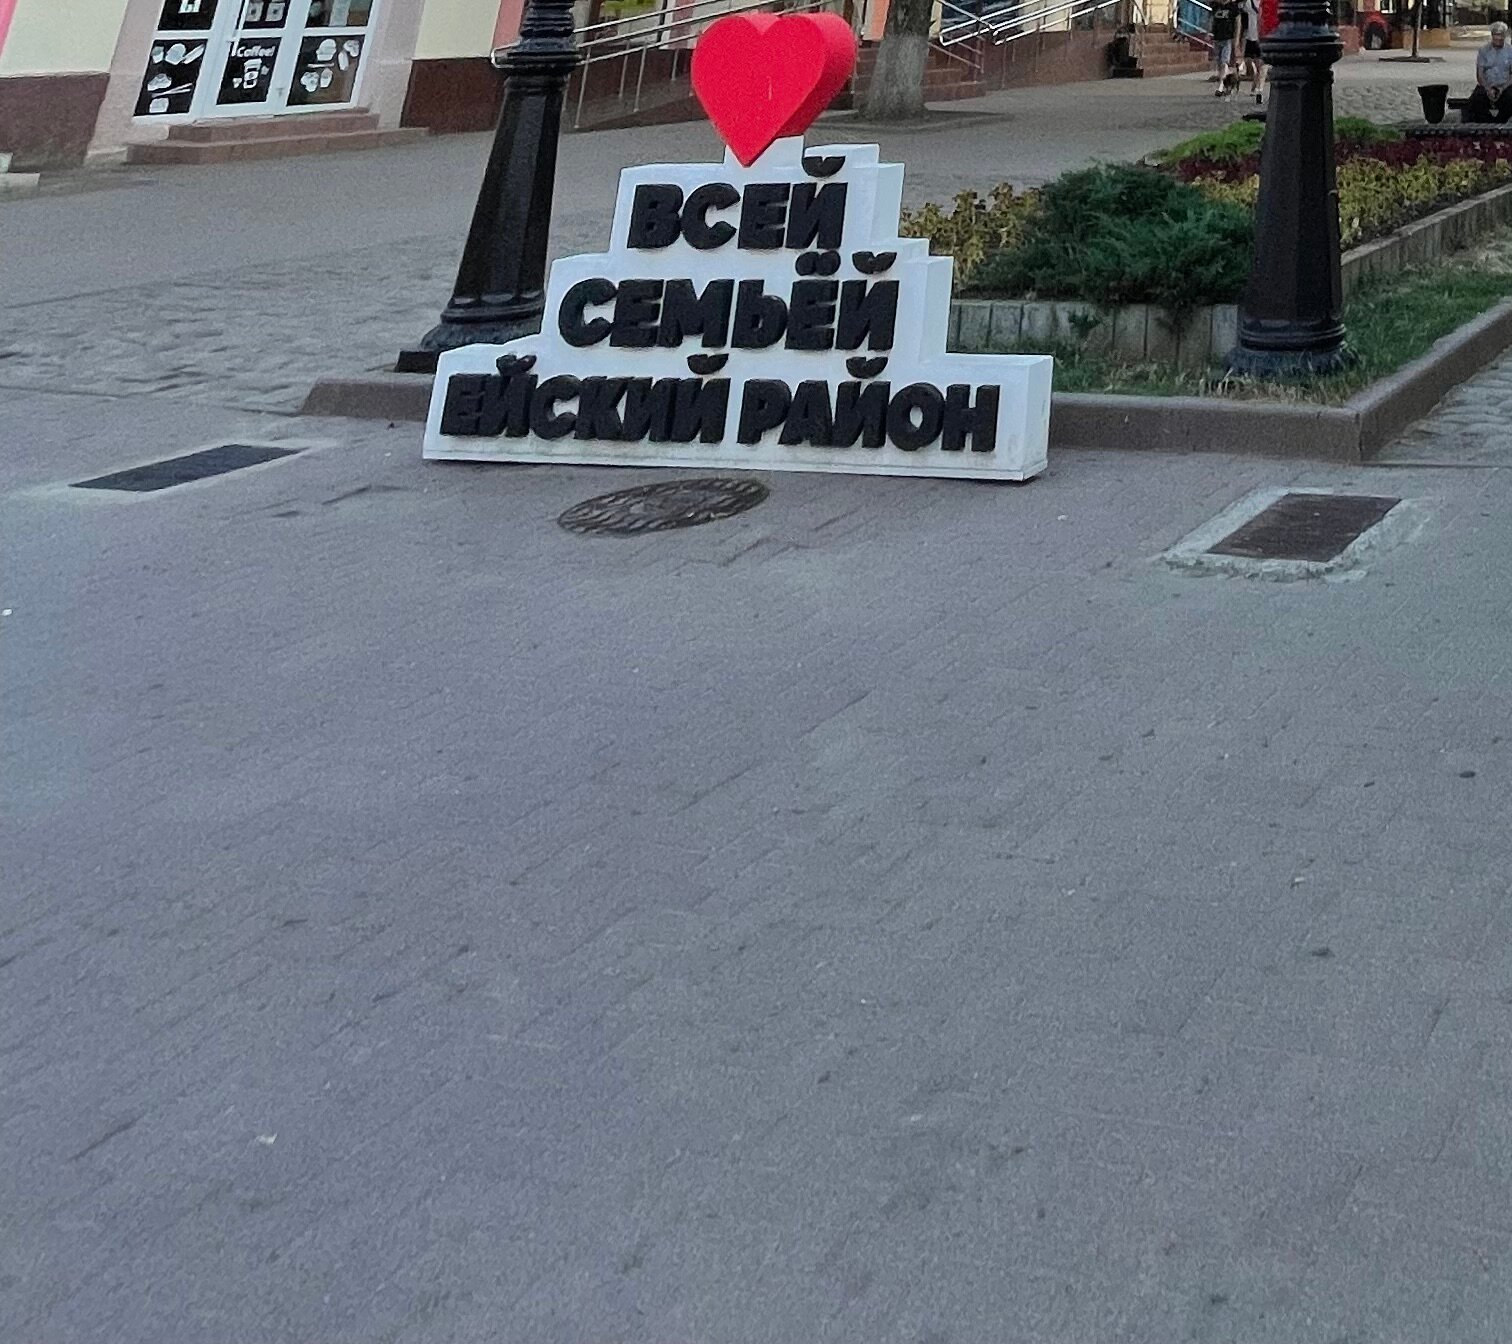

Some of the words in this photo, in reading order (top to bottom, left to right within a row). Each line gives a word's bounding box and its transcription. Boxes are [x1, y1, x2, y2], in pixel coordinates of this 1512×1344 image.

[626, 155, 849, 251] ВСЕЙ
[557, 250, 900, 352] СЕМЬЁЙ
[438, 353, 731, 445] ЕЙСКИЙ
[736, 355, 999, 453] РАЙОН
